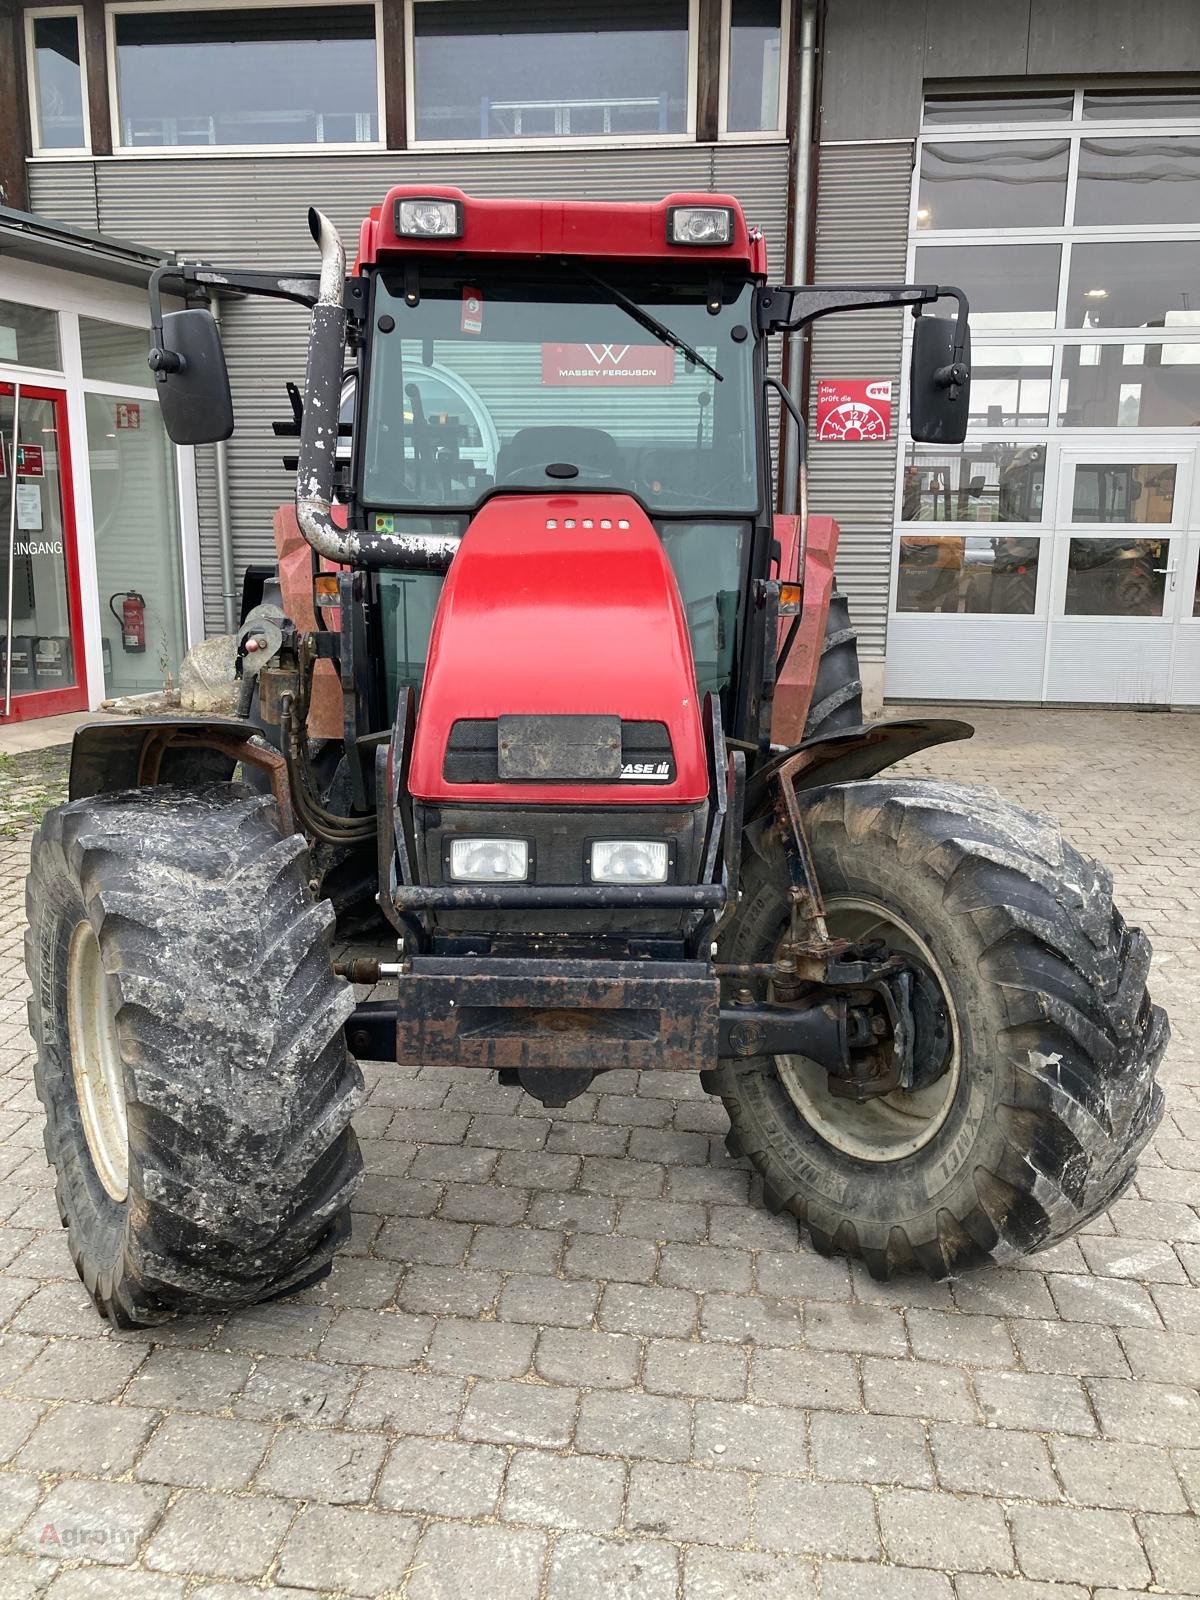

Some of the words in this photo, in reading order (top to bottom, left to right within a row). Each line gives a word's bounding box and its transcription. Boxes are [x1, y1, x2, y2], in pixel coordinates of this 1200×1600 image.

[559, 369, 600, 377] MASSEY
[821, 386, 836, 394] Hier
[831, 422, 840, 430] 2
[849, 411, 859, 420] 12
[860, 413, 869, 423] 11
[866, 420, 877, 431] 10
